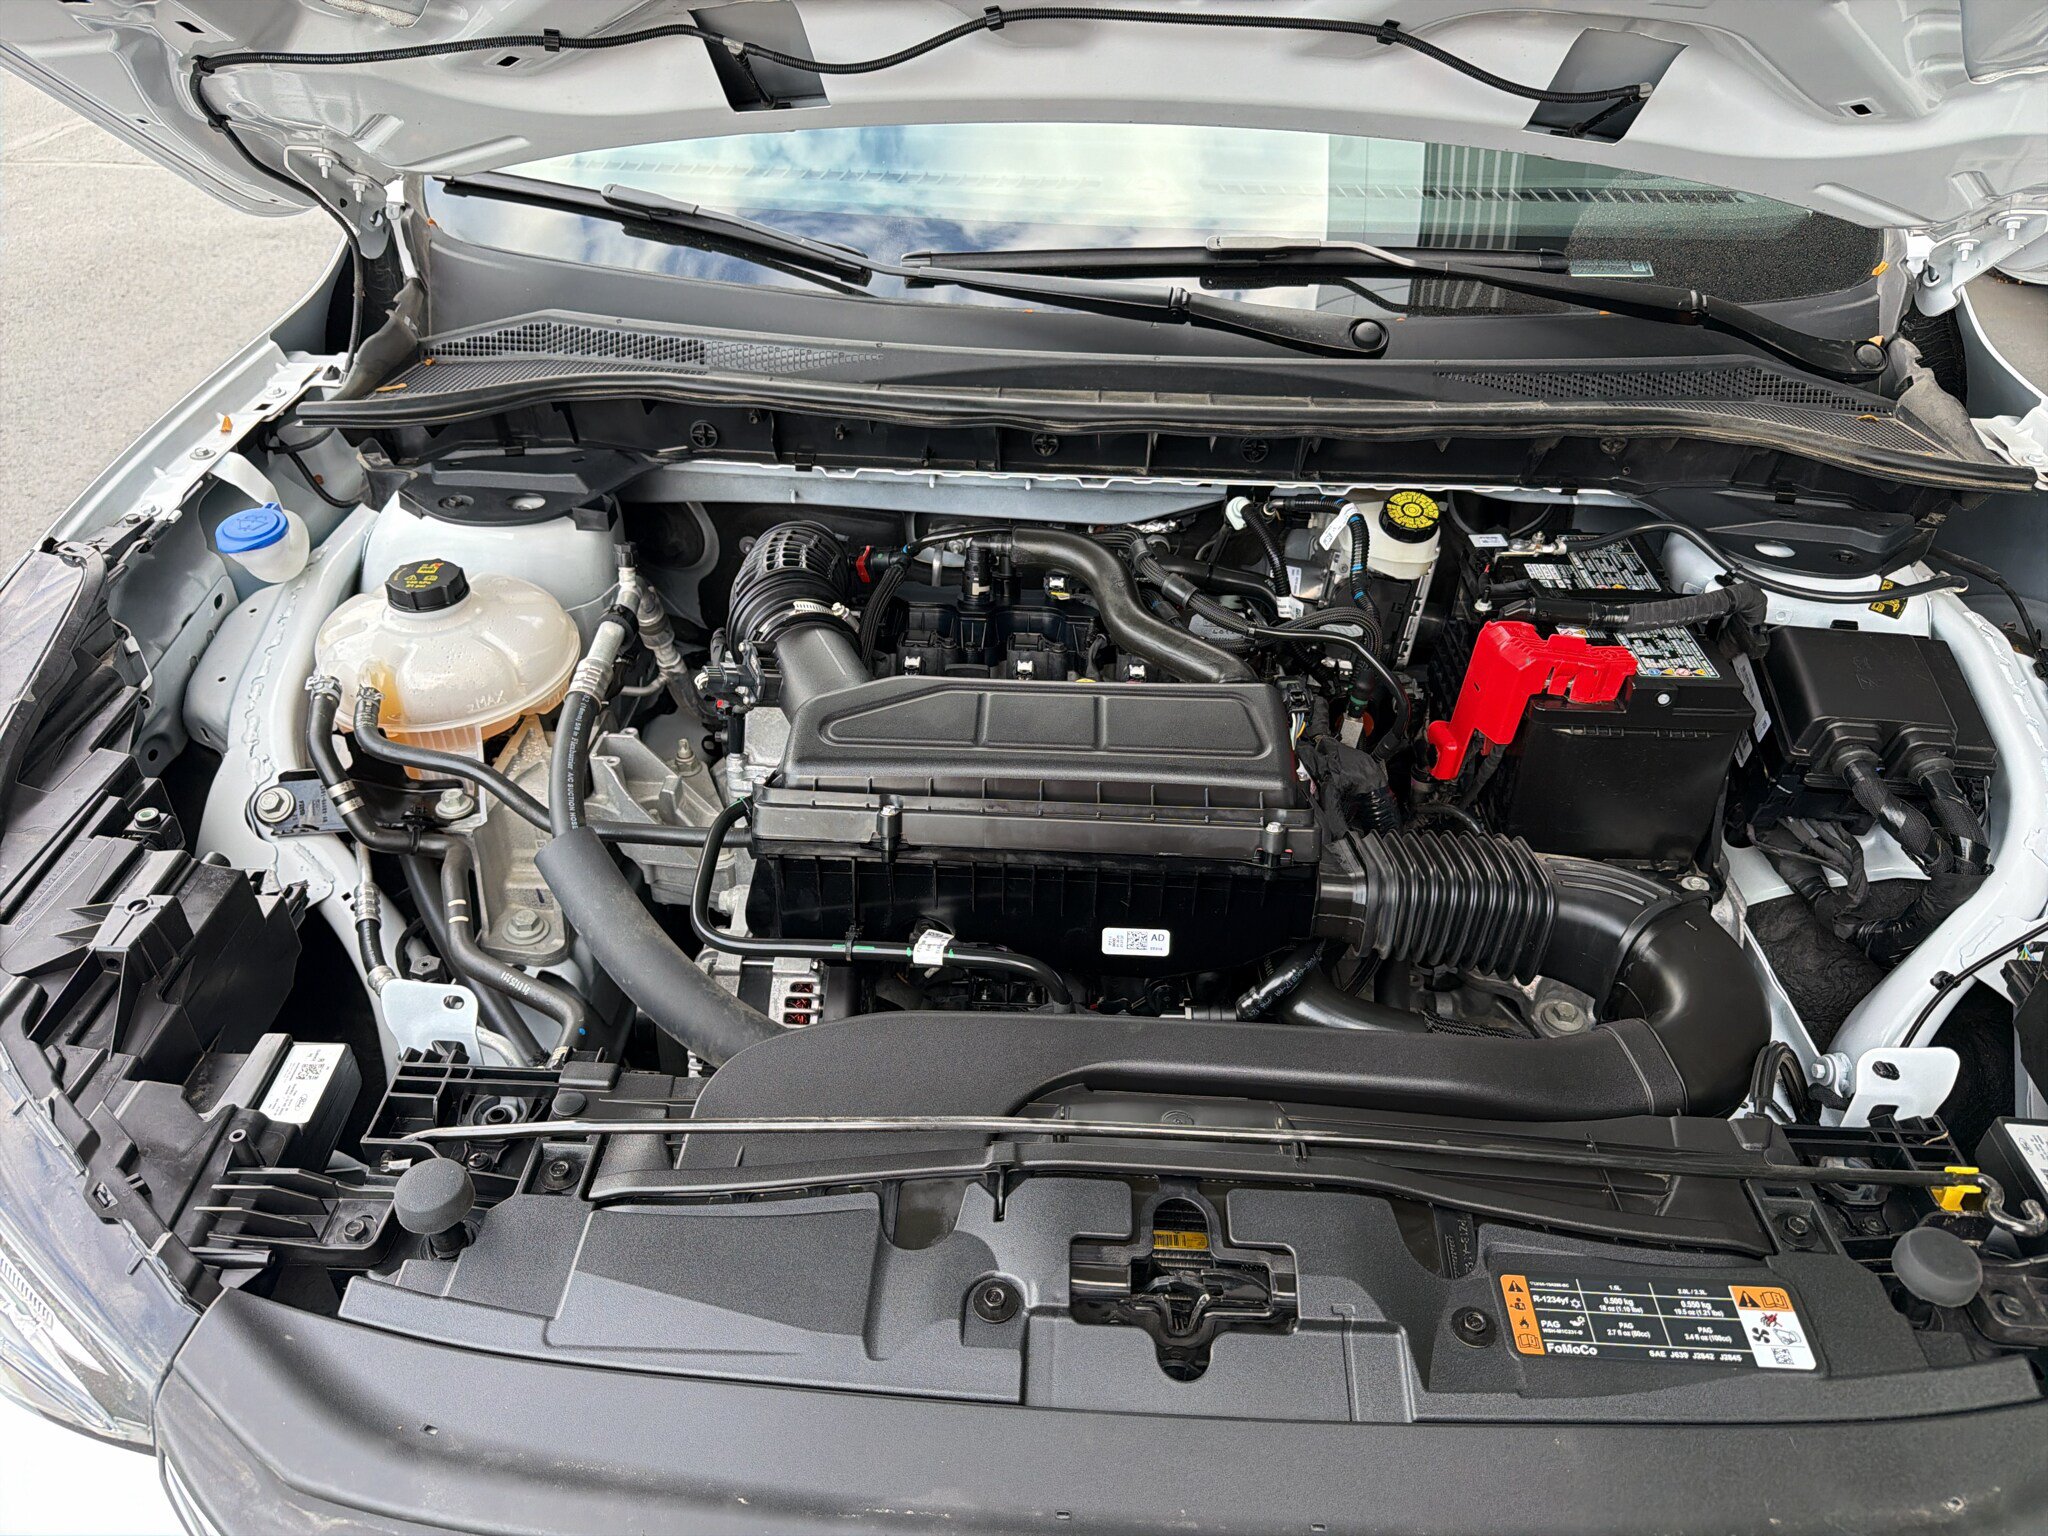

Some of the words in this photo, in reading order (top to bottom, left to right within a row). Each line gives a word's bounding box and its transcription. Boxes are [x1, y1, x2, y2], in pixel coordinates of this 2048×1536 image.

[567, 772, 575, 783] A/C
[567, 783, 576, 812] SUCTION
[1150, 934, 1165, 942] AD
[1532, 1294, 1569, 1306] R-1234yf
[1603, 1296, 1623, 1305] 0.500
[1624, 1298, 1634, 1307] kg
[1701, 1302, 1712, 1310] kg
[1540, 1320, 1561, 1328] PAG
[1546, 1342, 1598, 1356] FoMoCo
[1648, 1350, 1667, 1358] SAE
[1670, 1351, 1689, 1359] J639
